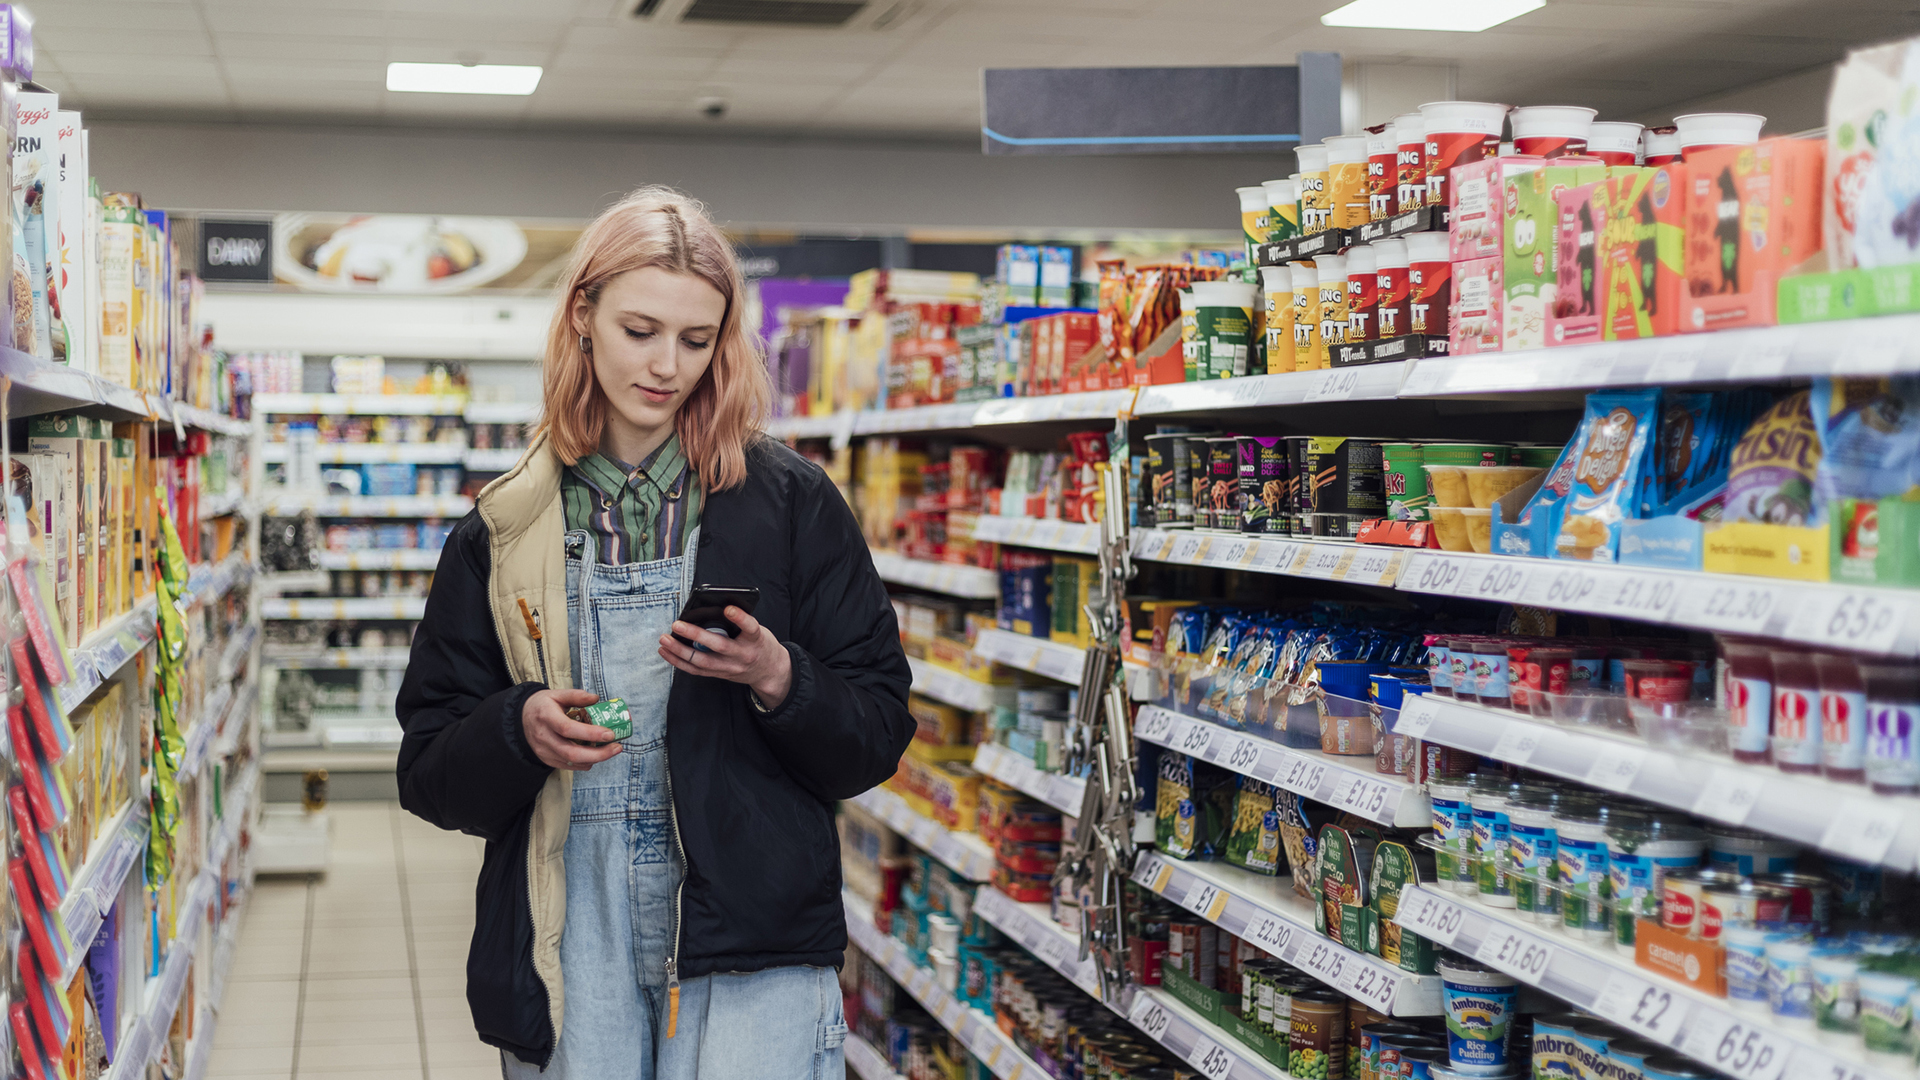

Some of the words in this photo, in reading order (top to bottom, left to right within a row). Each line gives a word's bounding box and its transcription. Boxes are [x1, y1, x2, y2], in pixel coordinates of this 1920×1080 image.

[207, 236, 266, 266] DAIRY
[1320, 371, 1357, 395] £1.40
[1590, 423, 1635, 460] Angel
[1580, 455, 1621, 486] Delight
[1226, 543, 1246, 562] 67p
[1275, 544, 1299, 569] £1
[1316, 553, 1340, 569] £1.30
[1363, 556, 1388, 573] £1.50
[1419, 558, 1458, 590] 60p
[1479, 563, 1523, 596] 60p
[1546, 569, 1596, 603] 60p
[1613, 575, 1675, 612] £1.10
[1703, 586, 1772, 621] £2.30
[1826, 594, 1894, 640] 65p
[1183, 722, 1210, 753] 85p
[1229, 739, 1259, 772] 85p
[1286, 760, 1325, 791] £1.15
[1344, 778, 1388, 813] £1.15
[1275, 804, 1301, 828] SAUCE
[1143, 860, 1161, 887] £1
[1195, 886, 1216, 914] £1
[1416, 899, 1463, 936] £1.60
[1257, 919, 1290, 949] £2.30
[1308, 944, 1346, 979] £2.75
[1496, 934, 1547, 976] £1.60
[1354, 966, 1396, 1004] £2.75
[1454, 984, 1478, 992] FRIDGE
[1142, 1005, 1168, 1034] 40p
[1451, 997, 1503, 1016] Ambrosia
[1630, 986, 1672, 1032] £2
[1302, 1038, 1314, 1046] Peas
[1458, 1047, 1495, 1061] Pudding
[1466, 1040, 1487, 1051] Rice
[1715, 1024, 1774, 1077] 65p
[1202, 1046, 1229, 1077] 45p
